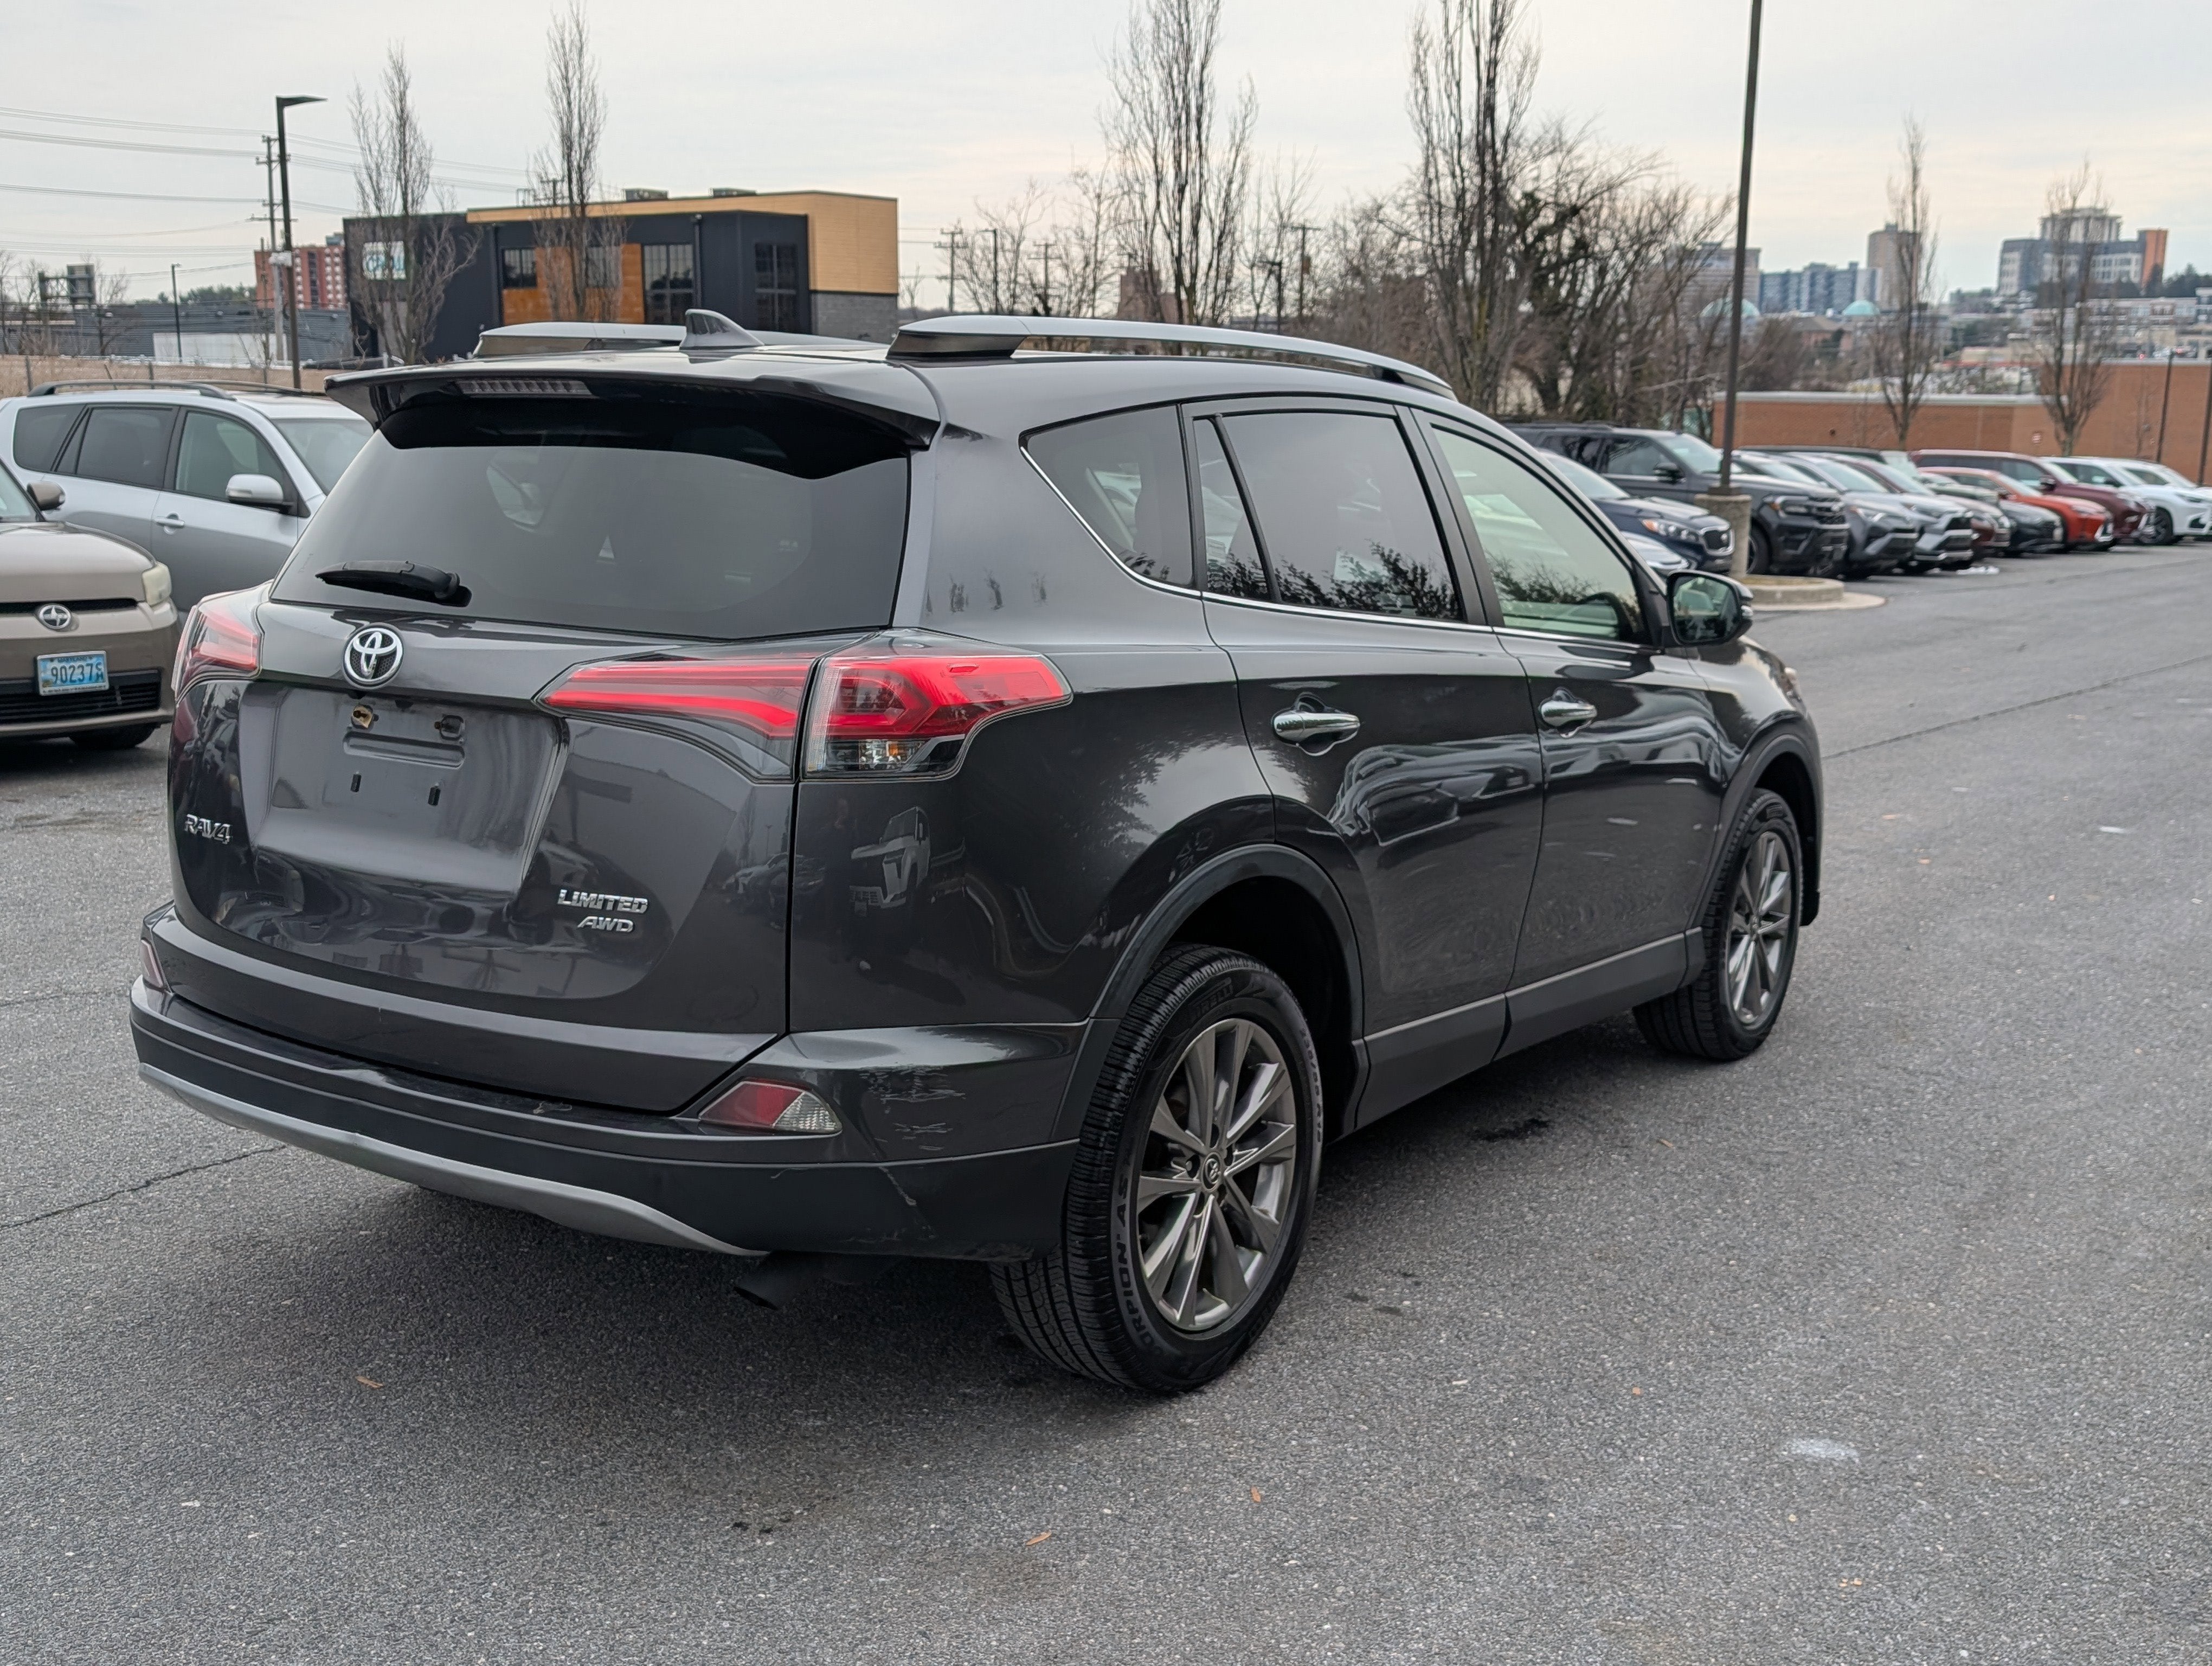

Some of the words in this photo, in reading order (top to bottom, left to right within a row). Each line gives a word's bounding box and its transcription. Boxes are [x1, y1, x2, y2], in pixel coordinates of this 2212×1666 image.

[51, 663, 93, 684] 90237
[184, 813, 233, 844] RAV4
[557, 889, 648, 913] LIMITED
[577, 915, 634, 932] AWD
